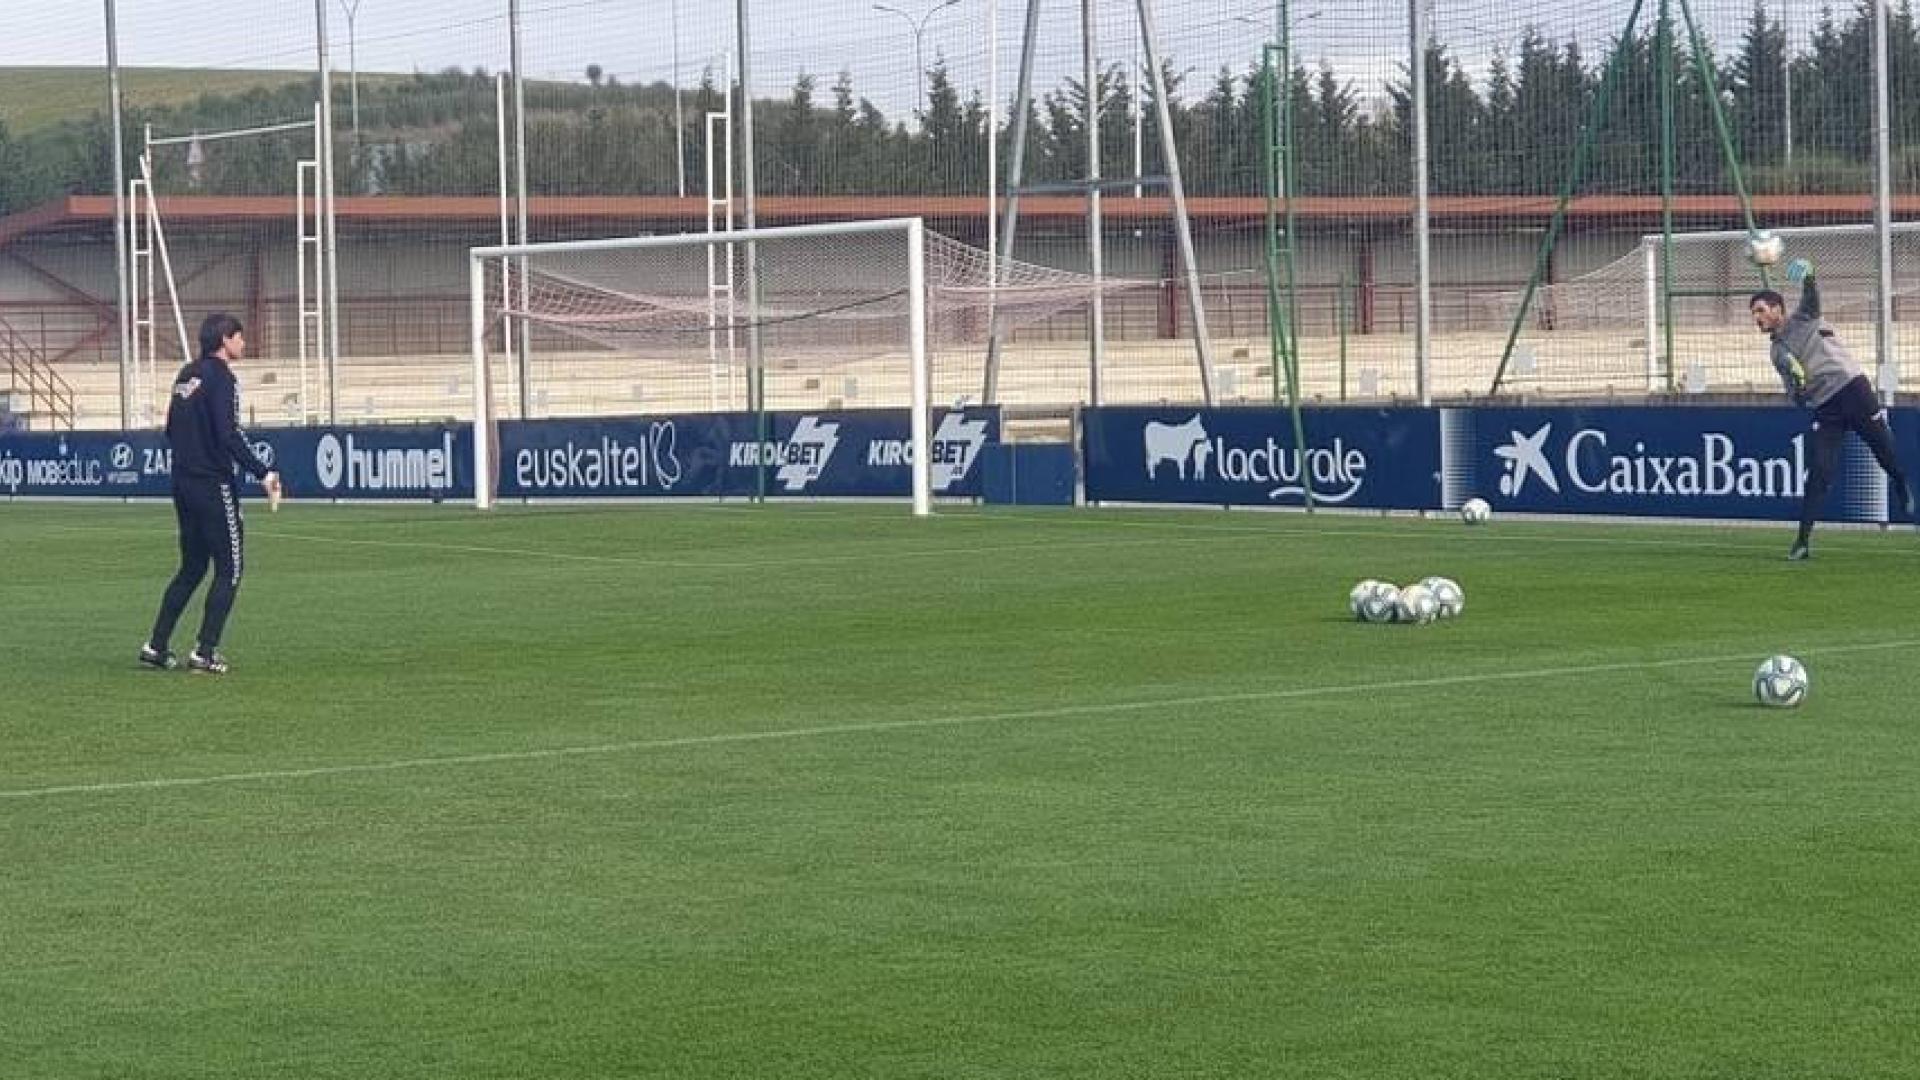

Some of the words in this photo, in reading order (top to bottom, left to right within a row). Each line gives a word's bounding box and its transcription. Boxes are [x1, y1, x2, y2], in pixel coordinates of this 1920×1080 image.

[346, 432, 453, 489] hummel
[516, 434, 647, 487] euskaltel
[867, 439, 972, 466] KIROBET
